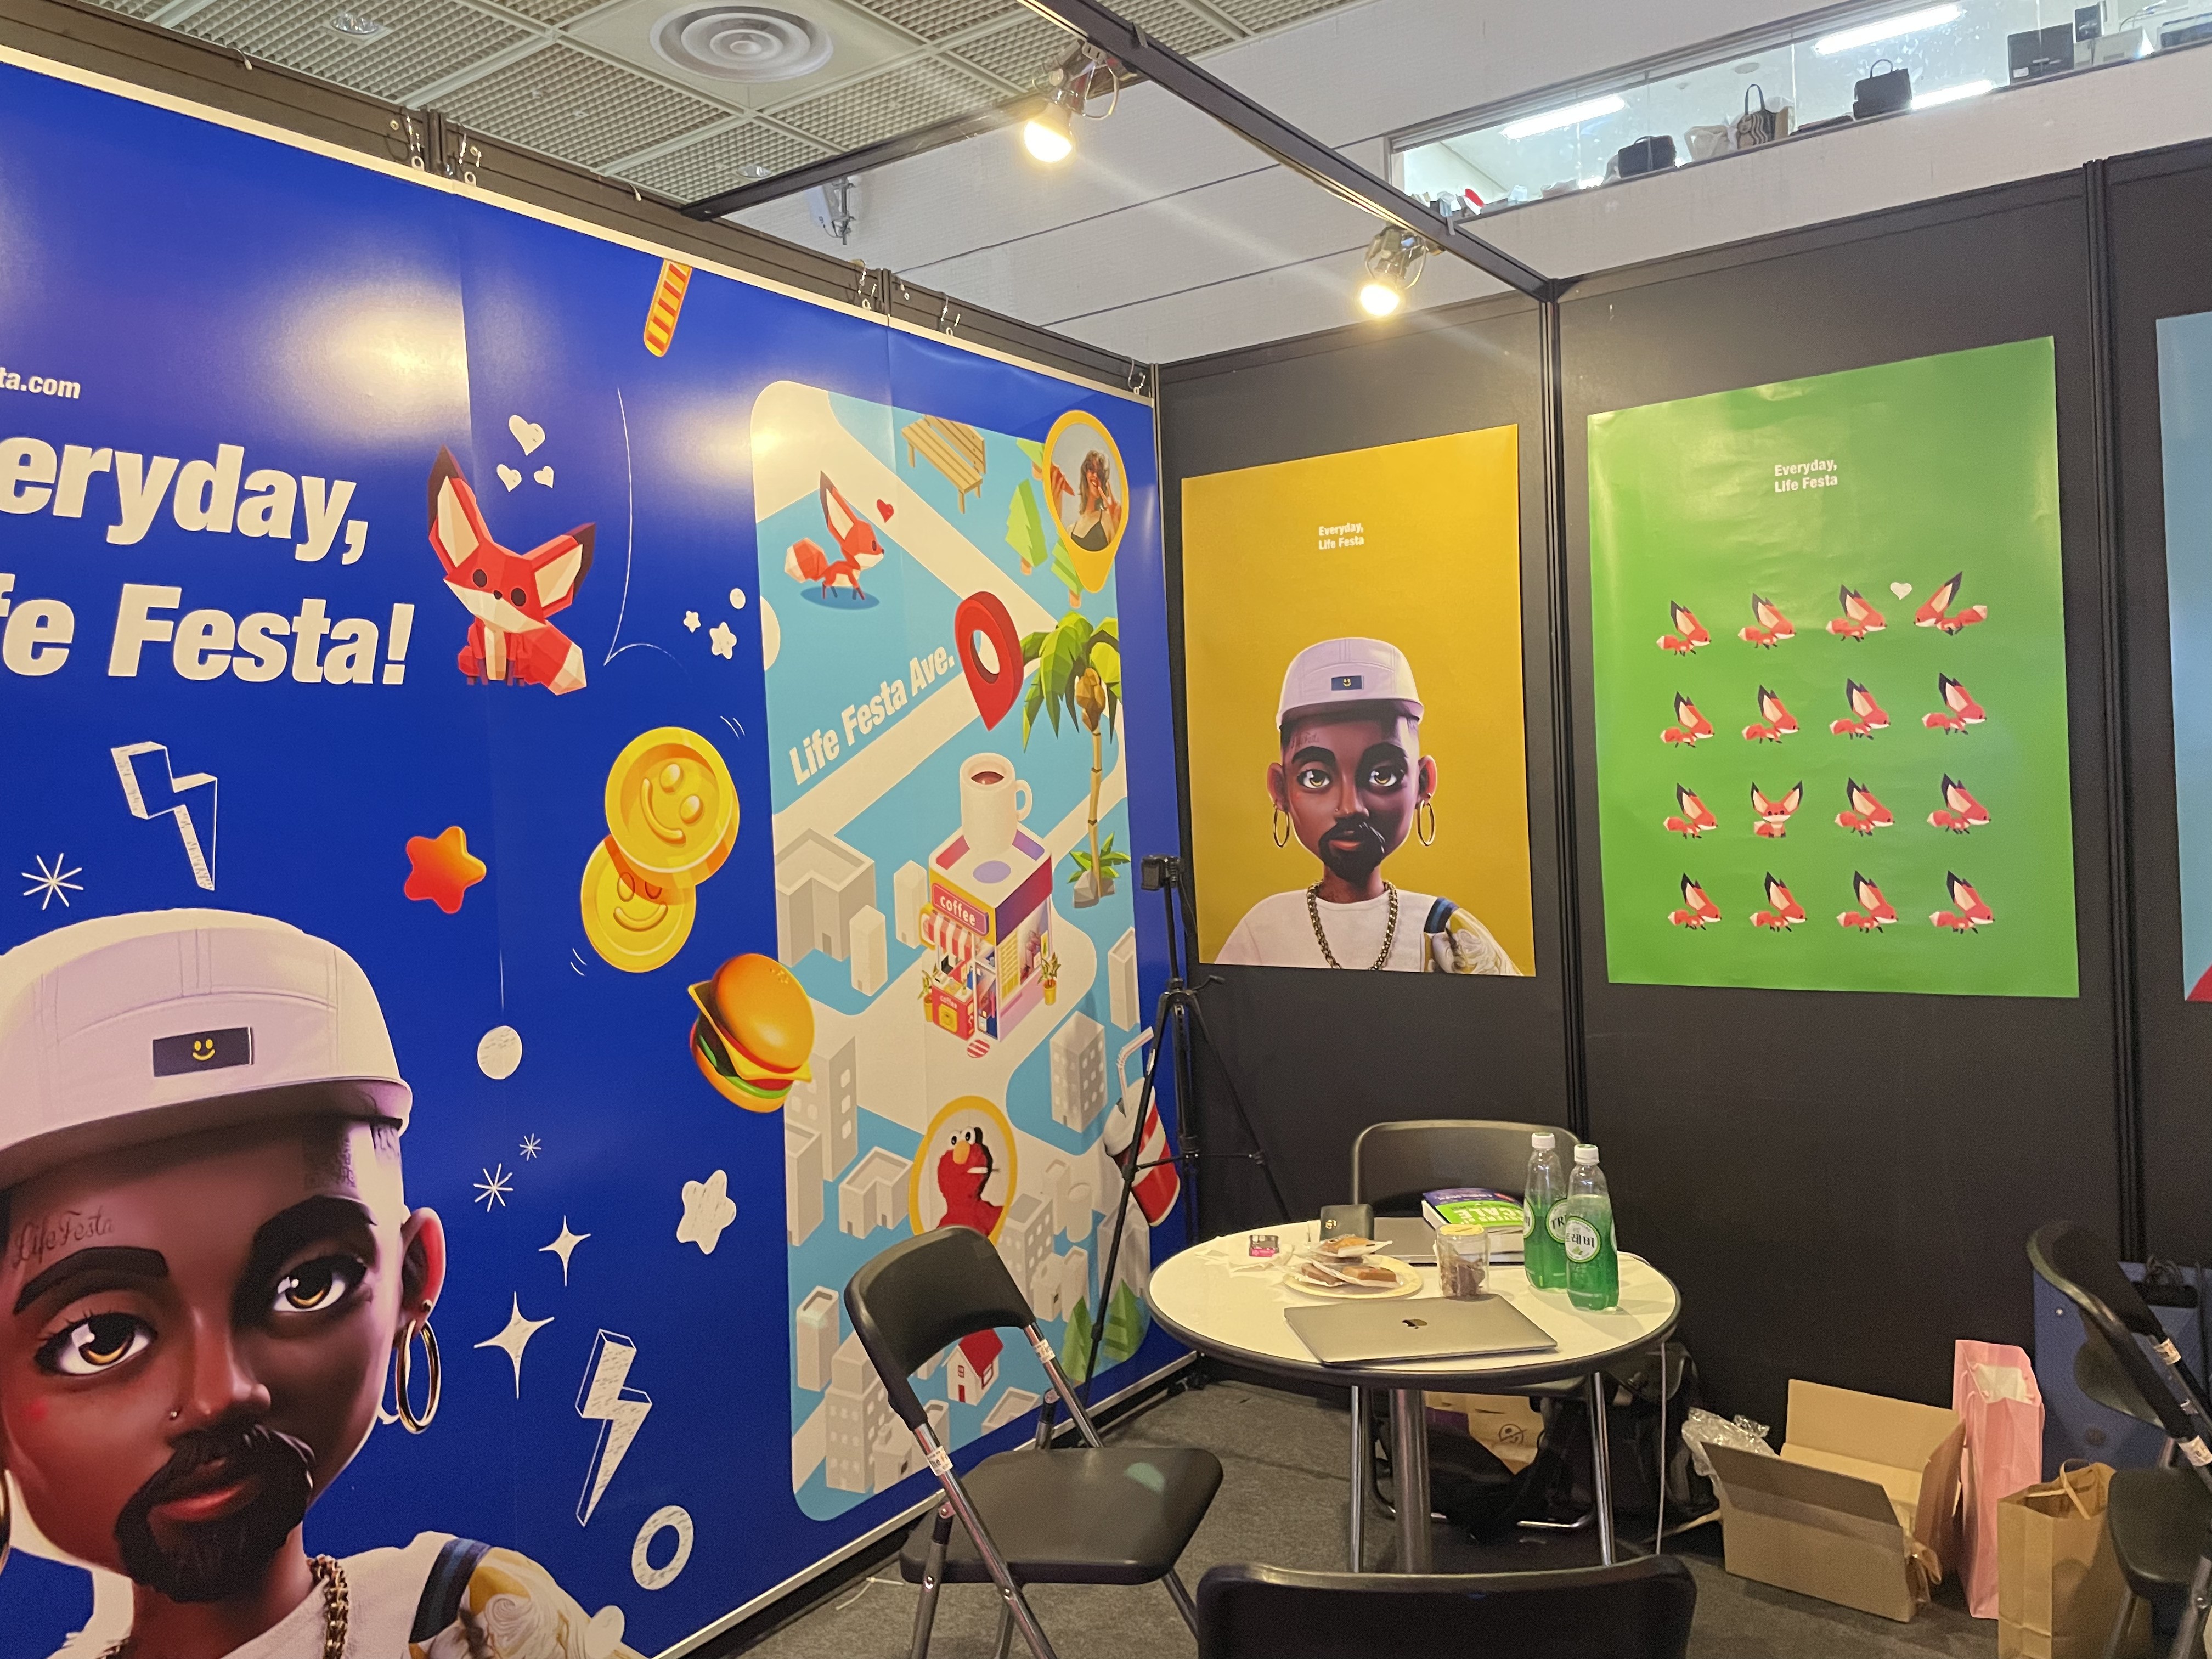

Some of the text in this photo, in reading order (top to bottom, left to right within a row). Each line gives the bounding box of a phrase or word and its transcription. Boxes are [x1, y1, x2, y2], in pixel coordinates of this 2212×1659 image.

[1774, 459, 1837, 476] Everyday,
[1774, 474, 1838, 493] Life Festa
[0, 437, 368, 565] eryday,
[1318, 522, 1364, 536] Everyday,
[1318, 535, 1364, 550] Life Festa
[108, 583, 415, 685] Festa!
[789, 646, 955, 786] Life Festa Ave.
[940, 896, 975, 926] coffee
[1550, 1215, 1567, 1230] TR
